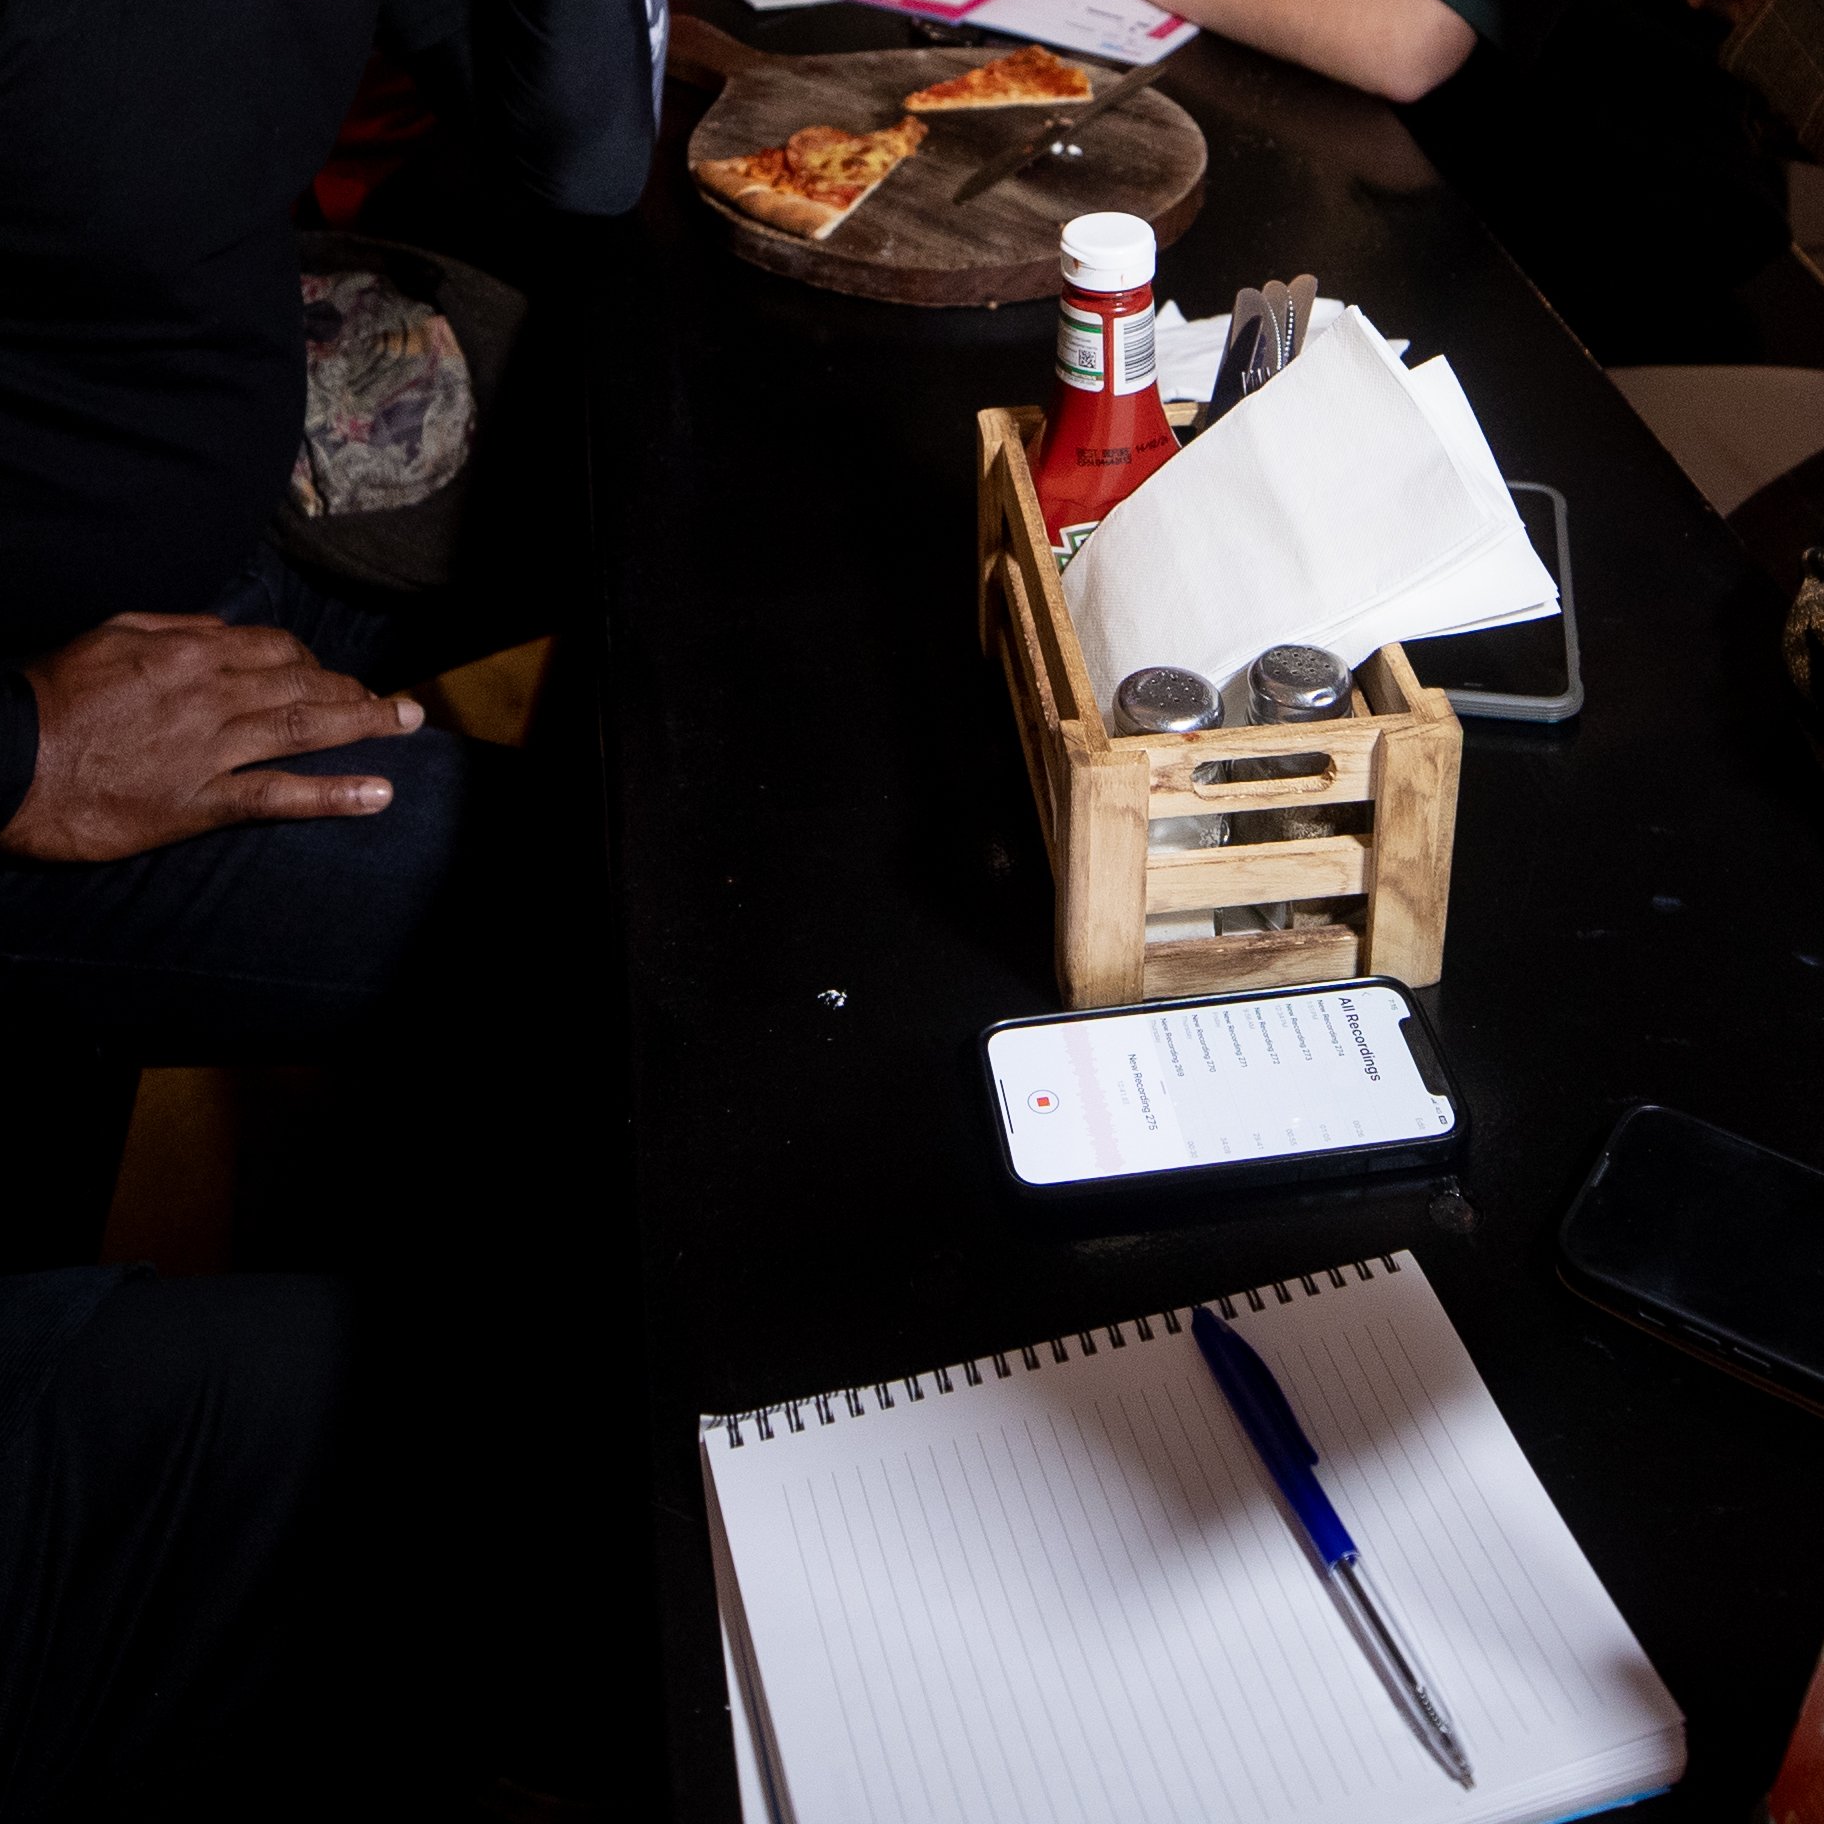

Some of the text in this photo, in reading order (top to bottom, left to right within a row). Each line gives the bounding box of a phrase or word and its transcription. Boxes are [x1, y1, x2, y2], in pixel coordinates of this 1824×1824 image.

[1160, 1017, 1169, 1032] New
[1192, 1013, 1200, 1028] New
[1196, 1028, 1211, 1061] Recording
[1223, 1010, 1231, 1025] New
[1227, 1024, 1243, 1057] Recording
[1254, 1006, 1262, 1021] New
[1258, 1020, 1275, 1053] Recording
[1285, 1003, 1294, 1017] New
[1290, 1017, 1307, 1049] Recording
[1316, 999, 1326, 1013] New
[1322, 1013, 1339, 1045] Recording
[1337, 997, 1381, 1082] All Recordings
[1164, 1031, 1180, 1064] Recording
[1127, 1053, 1159, 1131] New Recording 275
